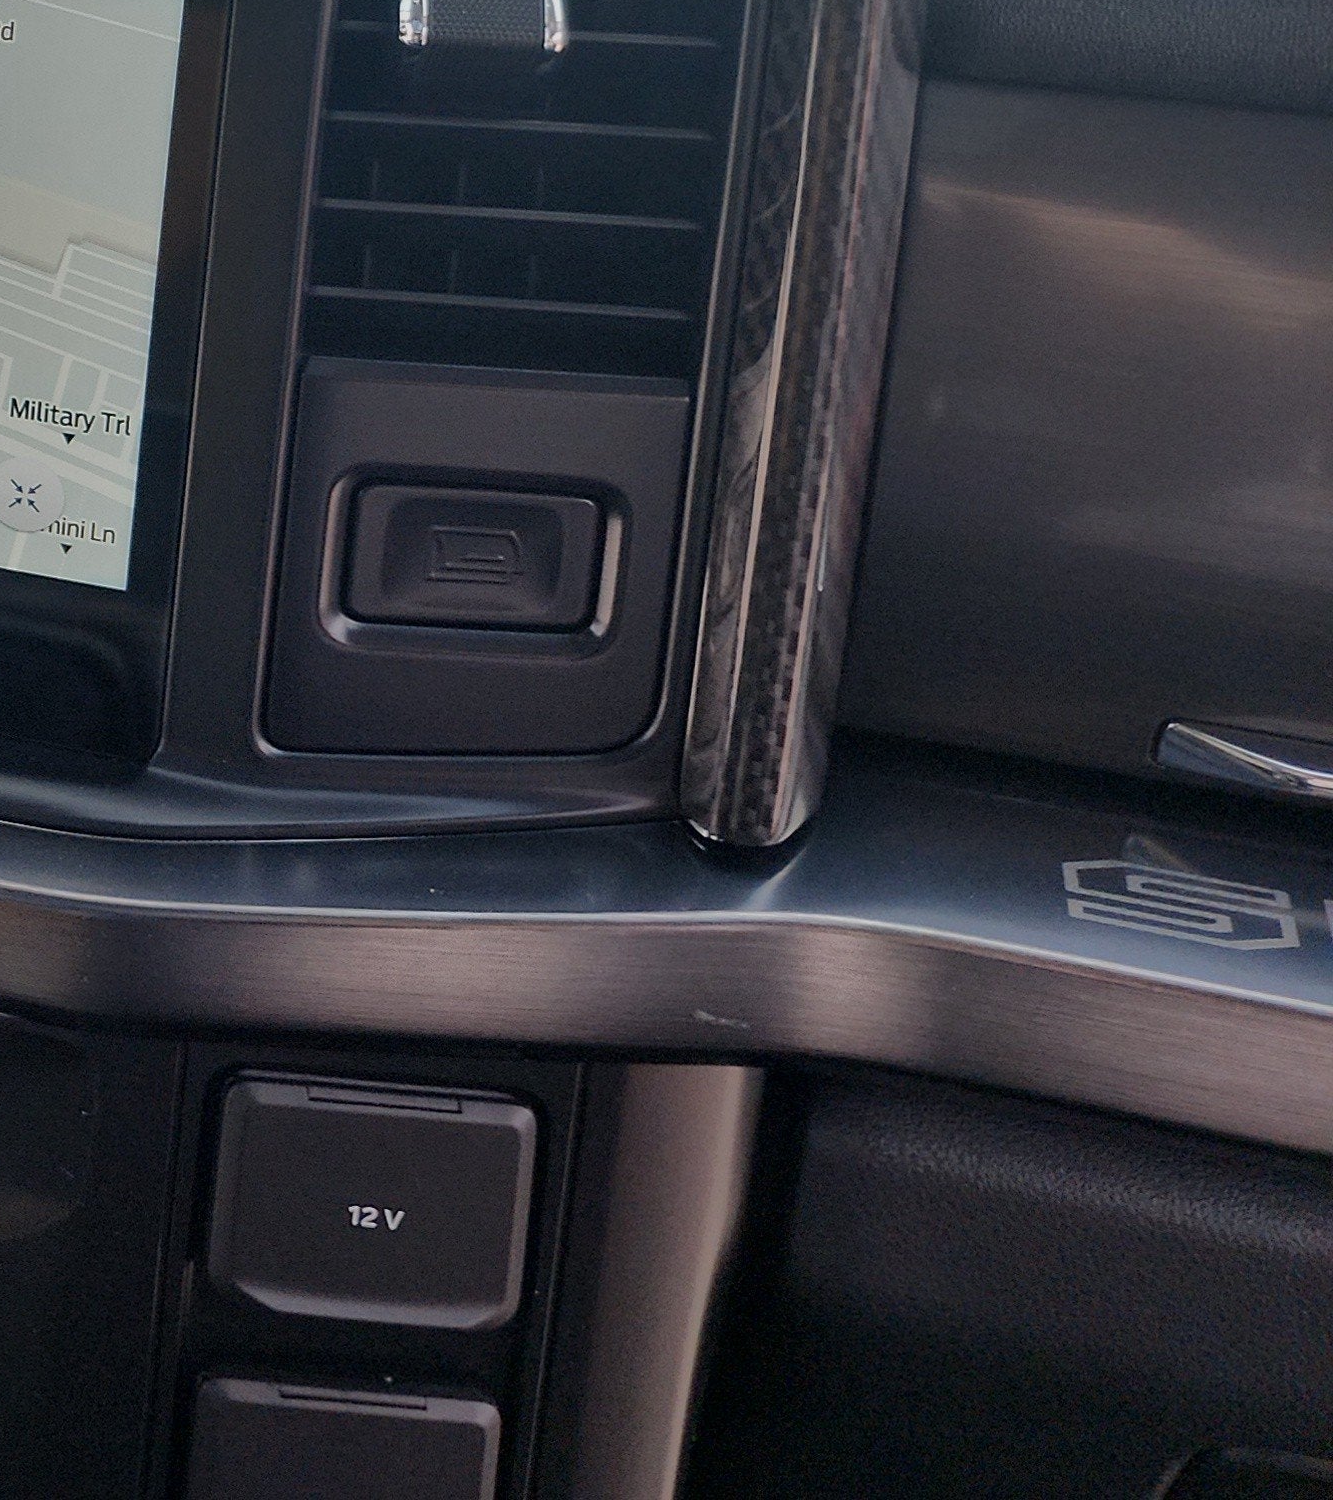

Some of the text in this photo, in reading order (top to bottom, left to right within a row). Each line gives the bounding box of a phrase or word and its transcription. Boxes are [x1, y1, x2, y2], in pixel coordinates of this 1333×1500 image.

[9, 398, 131, 437] Military Trl
[91, 522, 115, 544] Ln
